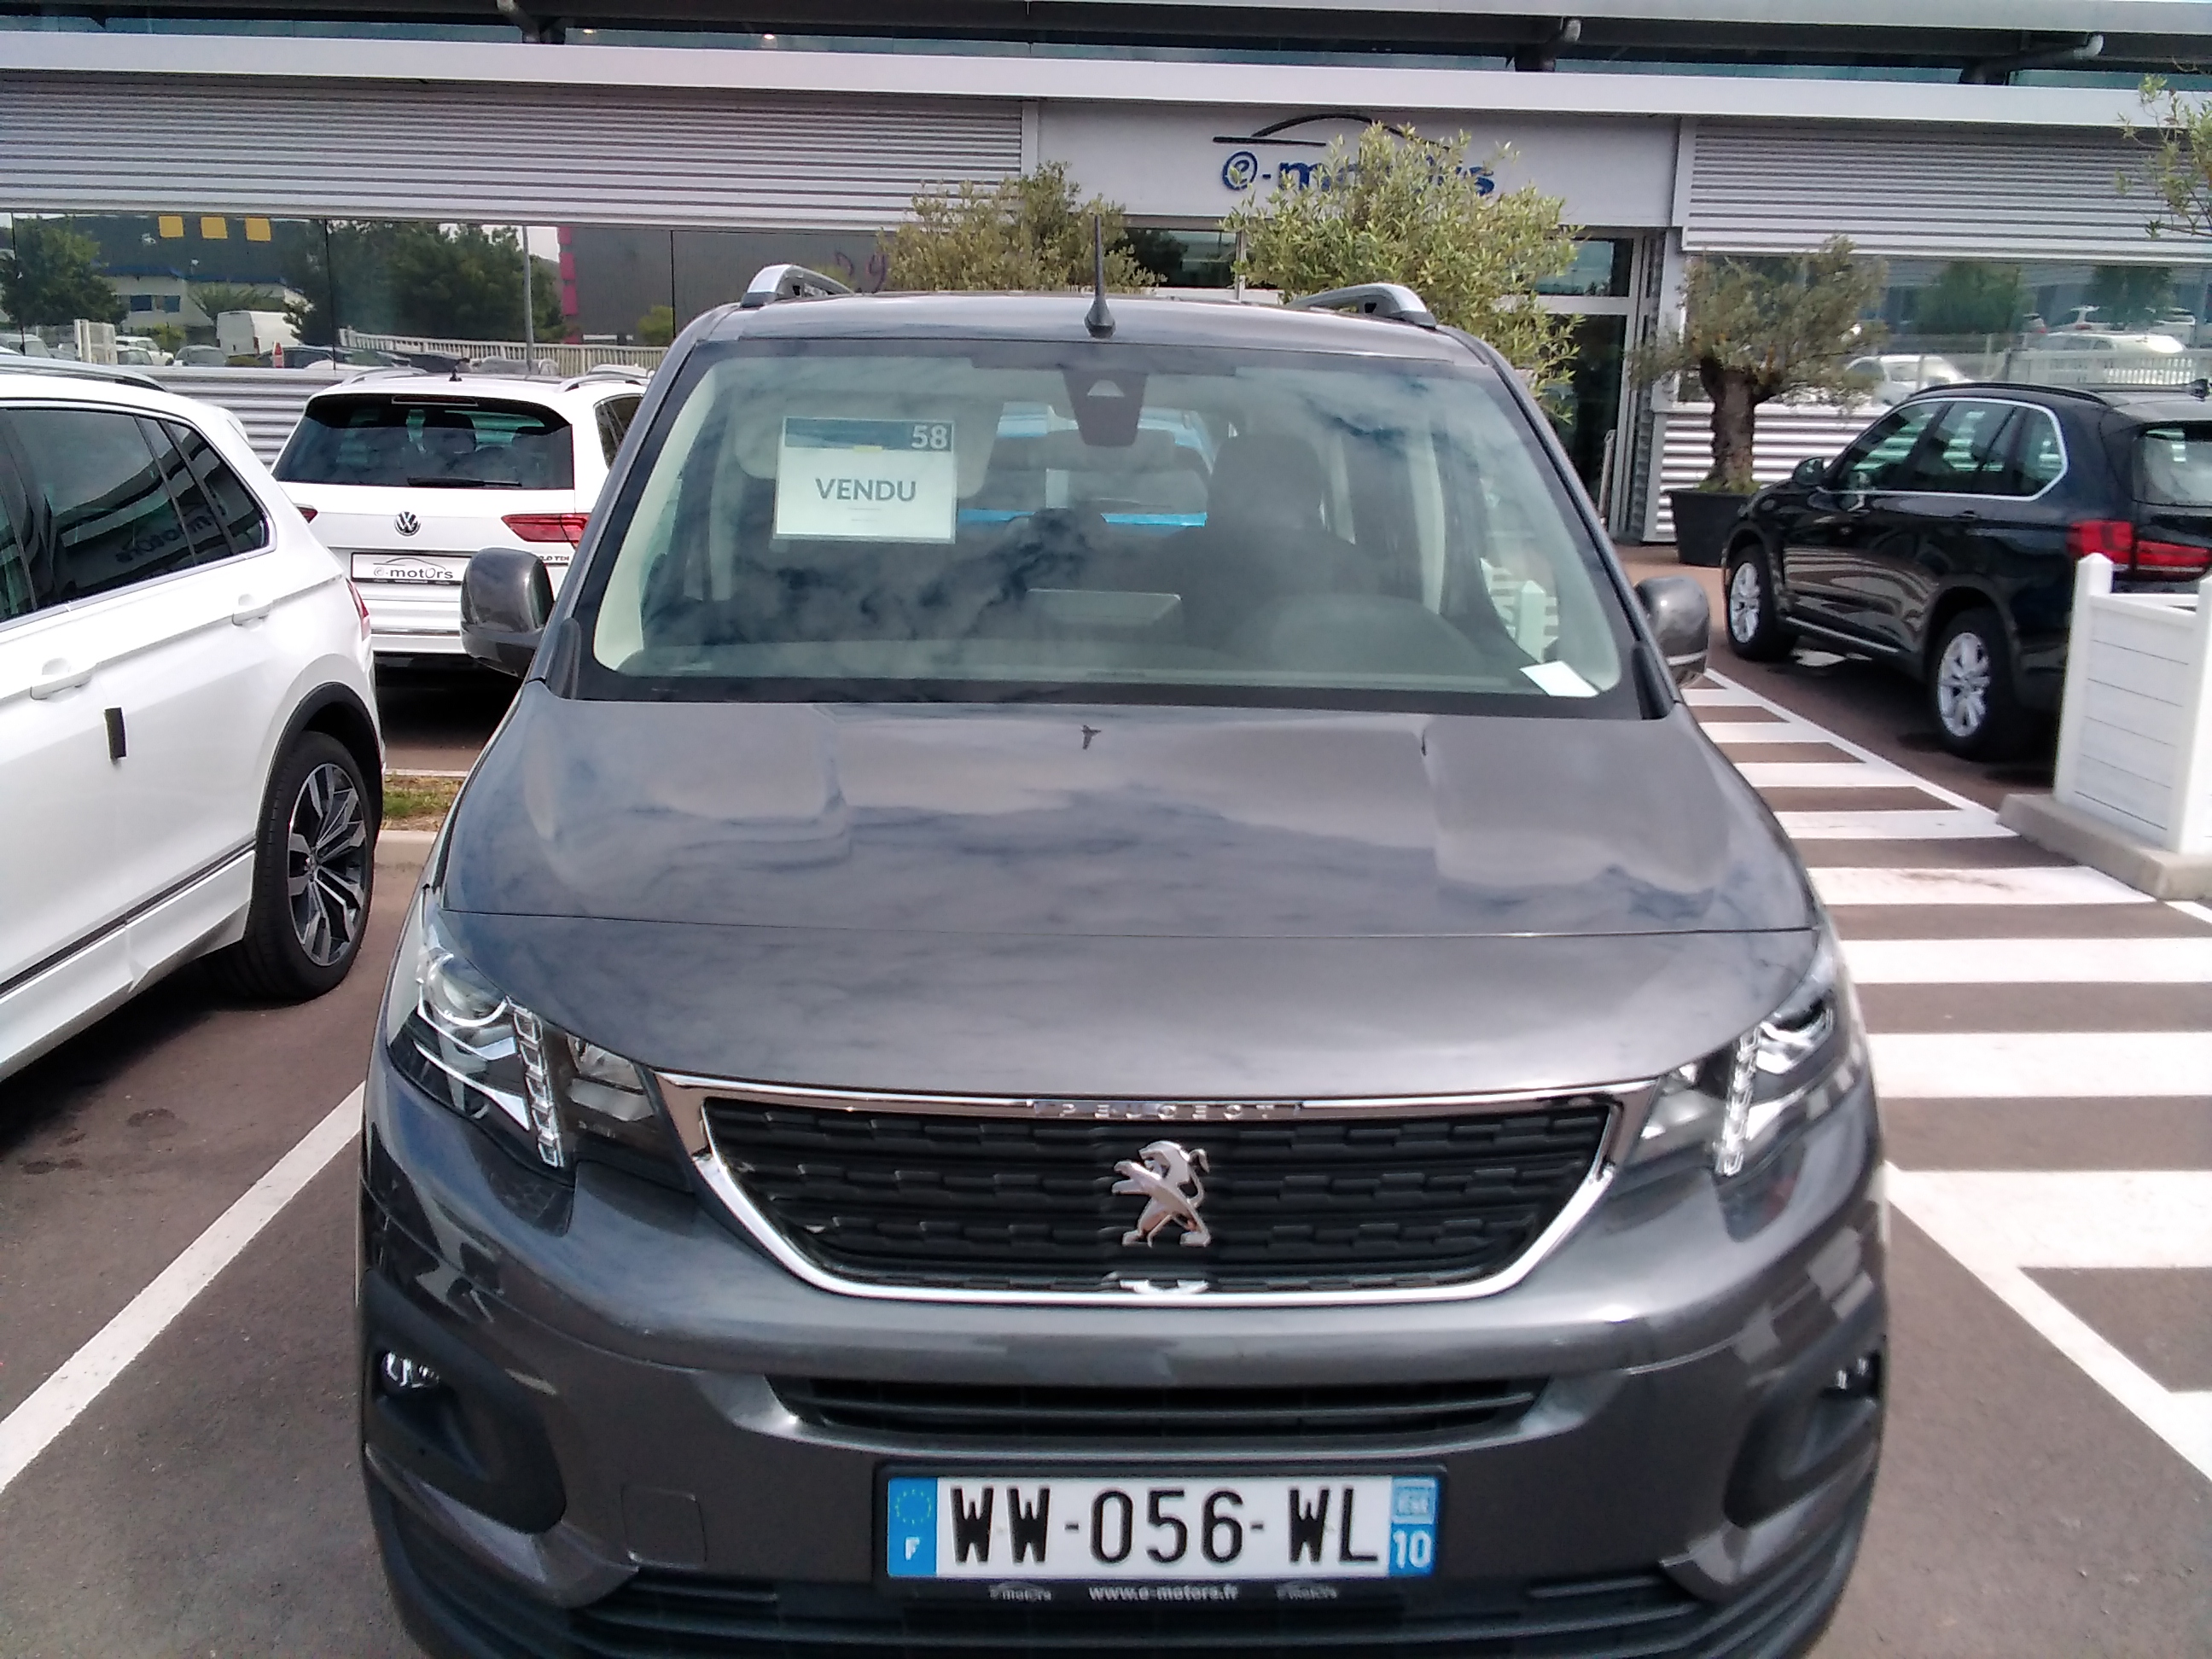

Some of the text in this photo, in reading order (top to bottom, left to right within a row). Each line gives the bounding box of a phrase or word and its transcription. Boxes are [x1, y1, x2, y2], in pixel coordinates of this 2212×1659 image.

[911, 424, 948, 450] 58
[815, 477, 917, 502] VENDU
[905, 1536, 921, 1561] F
[1392, 1529, 1432, 1569] 10
